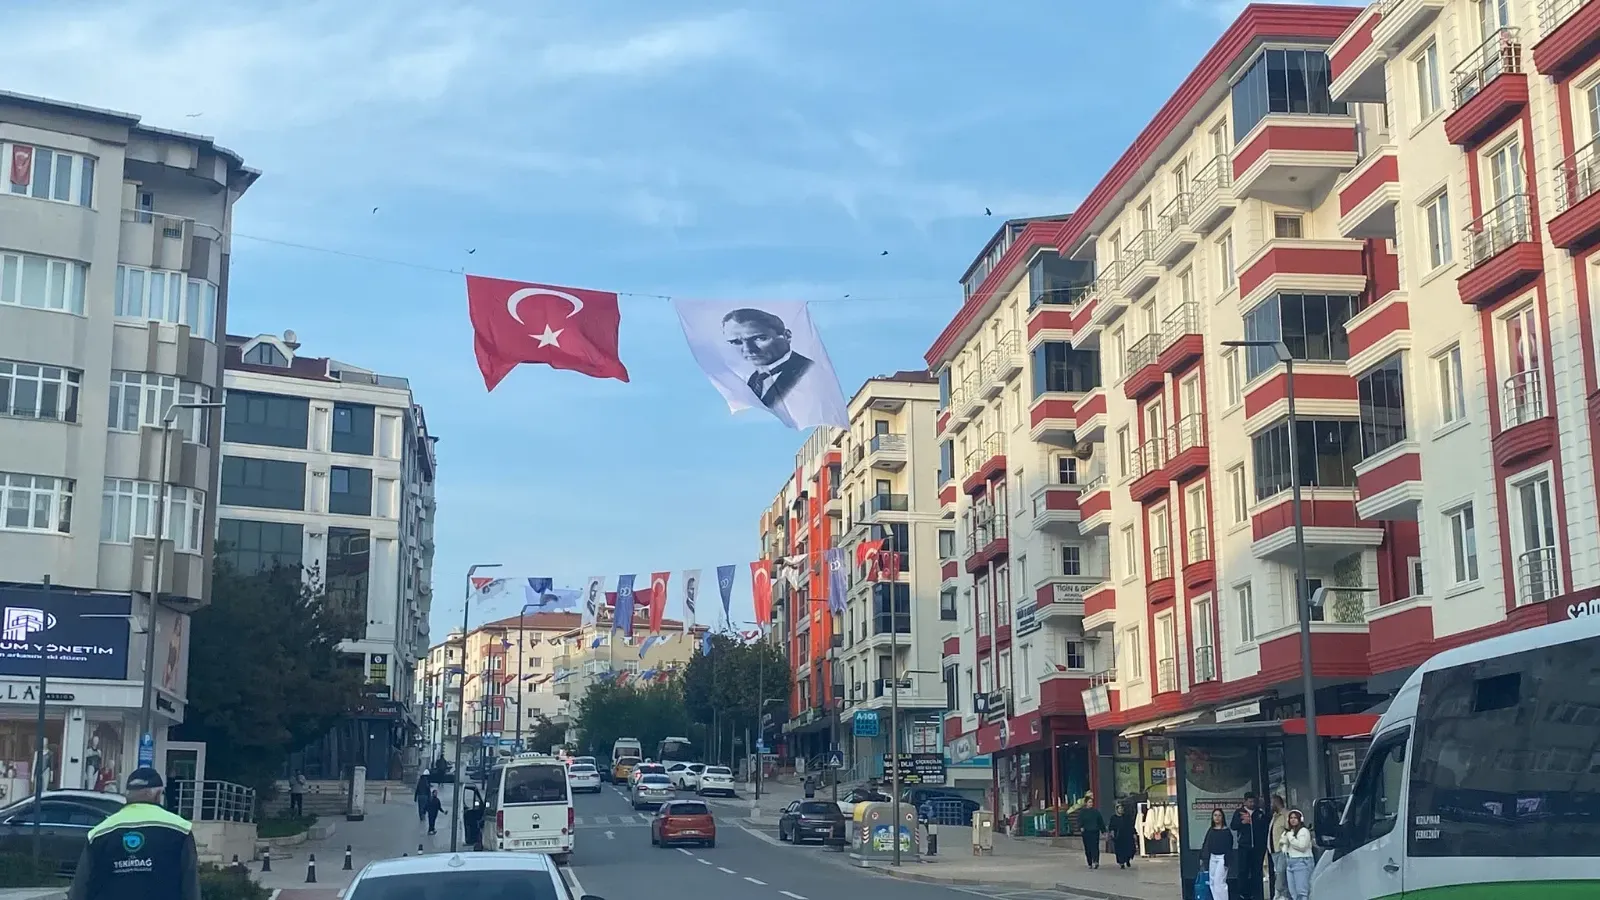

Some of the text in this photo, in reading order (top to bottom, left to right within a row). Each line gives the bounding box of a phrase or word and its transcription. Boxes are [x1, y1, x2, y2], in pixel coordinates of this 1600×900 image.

[34, 643, 113, 655] YÖNETİM
[0, 685, 36, 700] LA
[1152, 769, 1166, 778] SEÇ
[113, 858, 152, 868] TEKİRDAĞ
